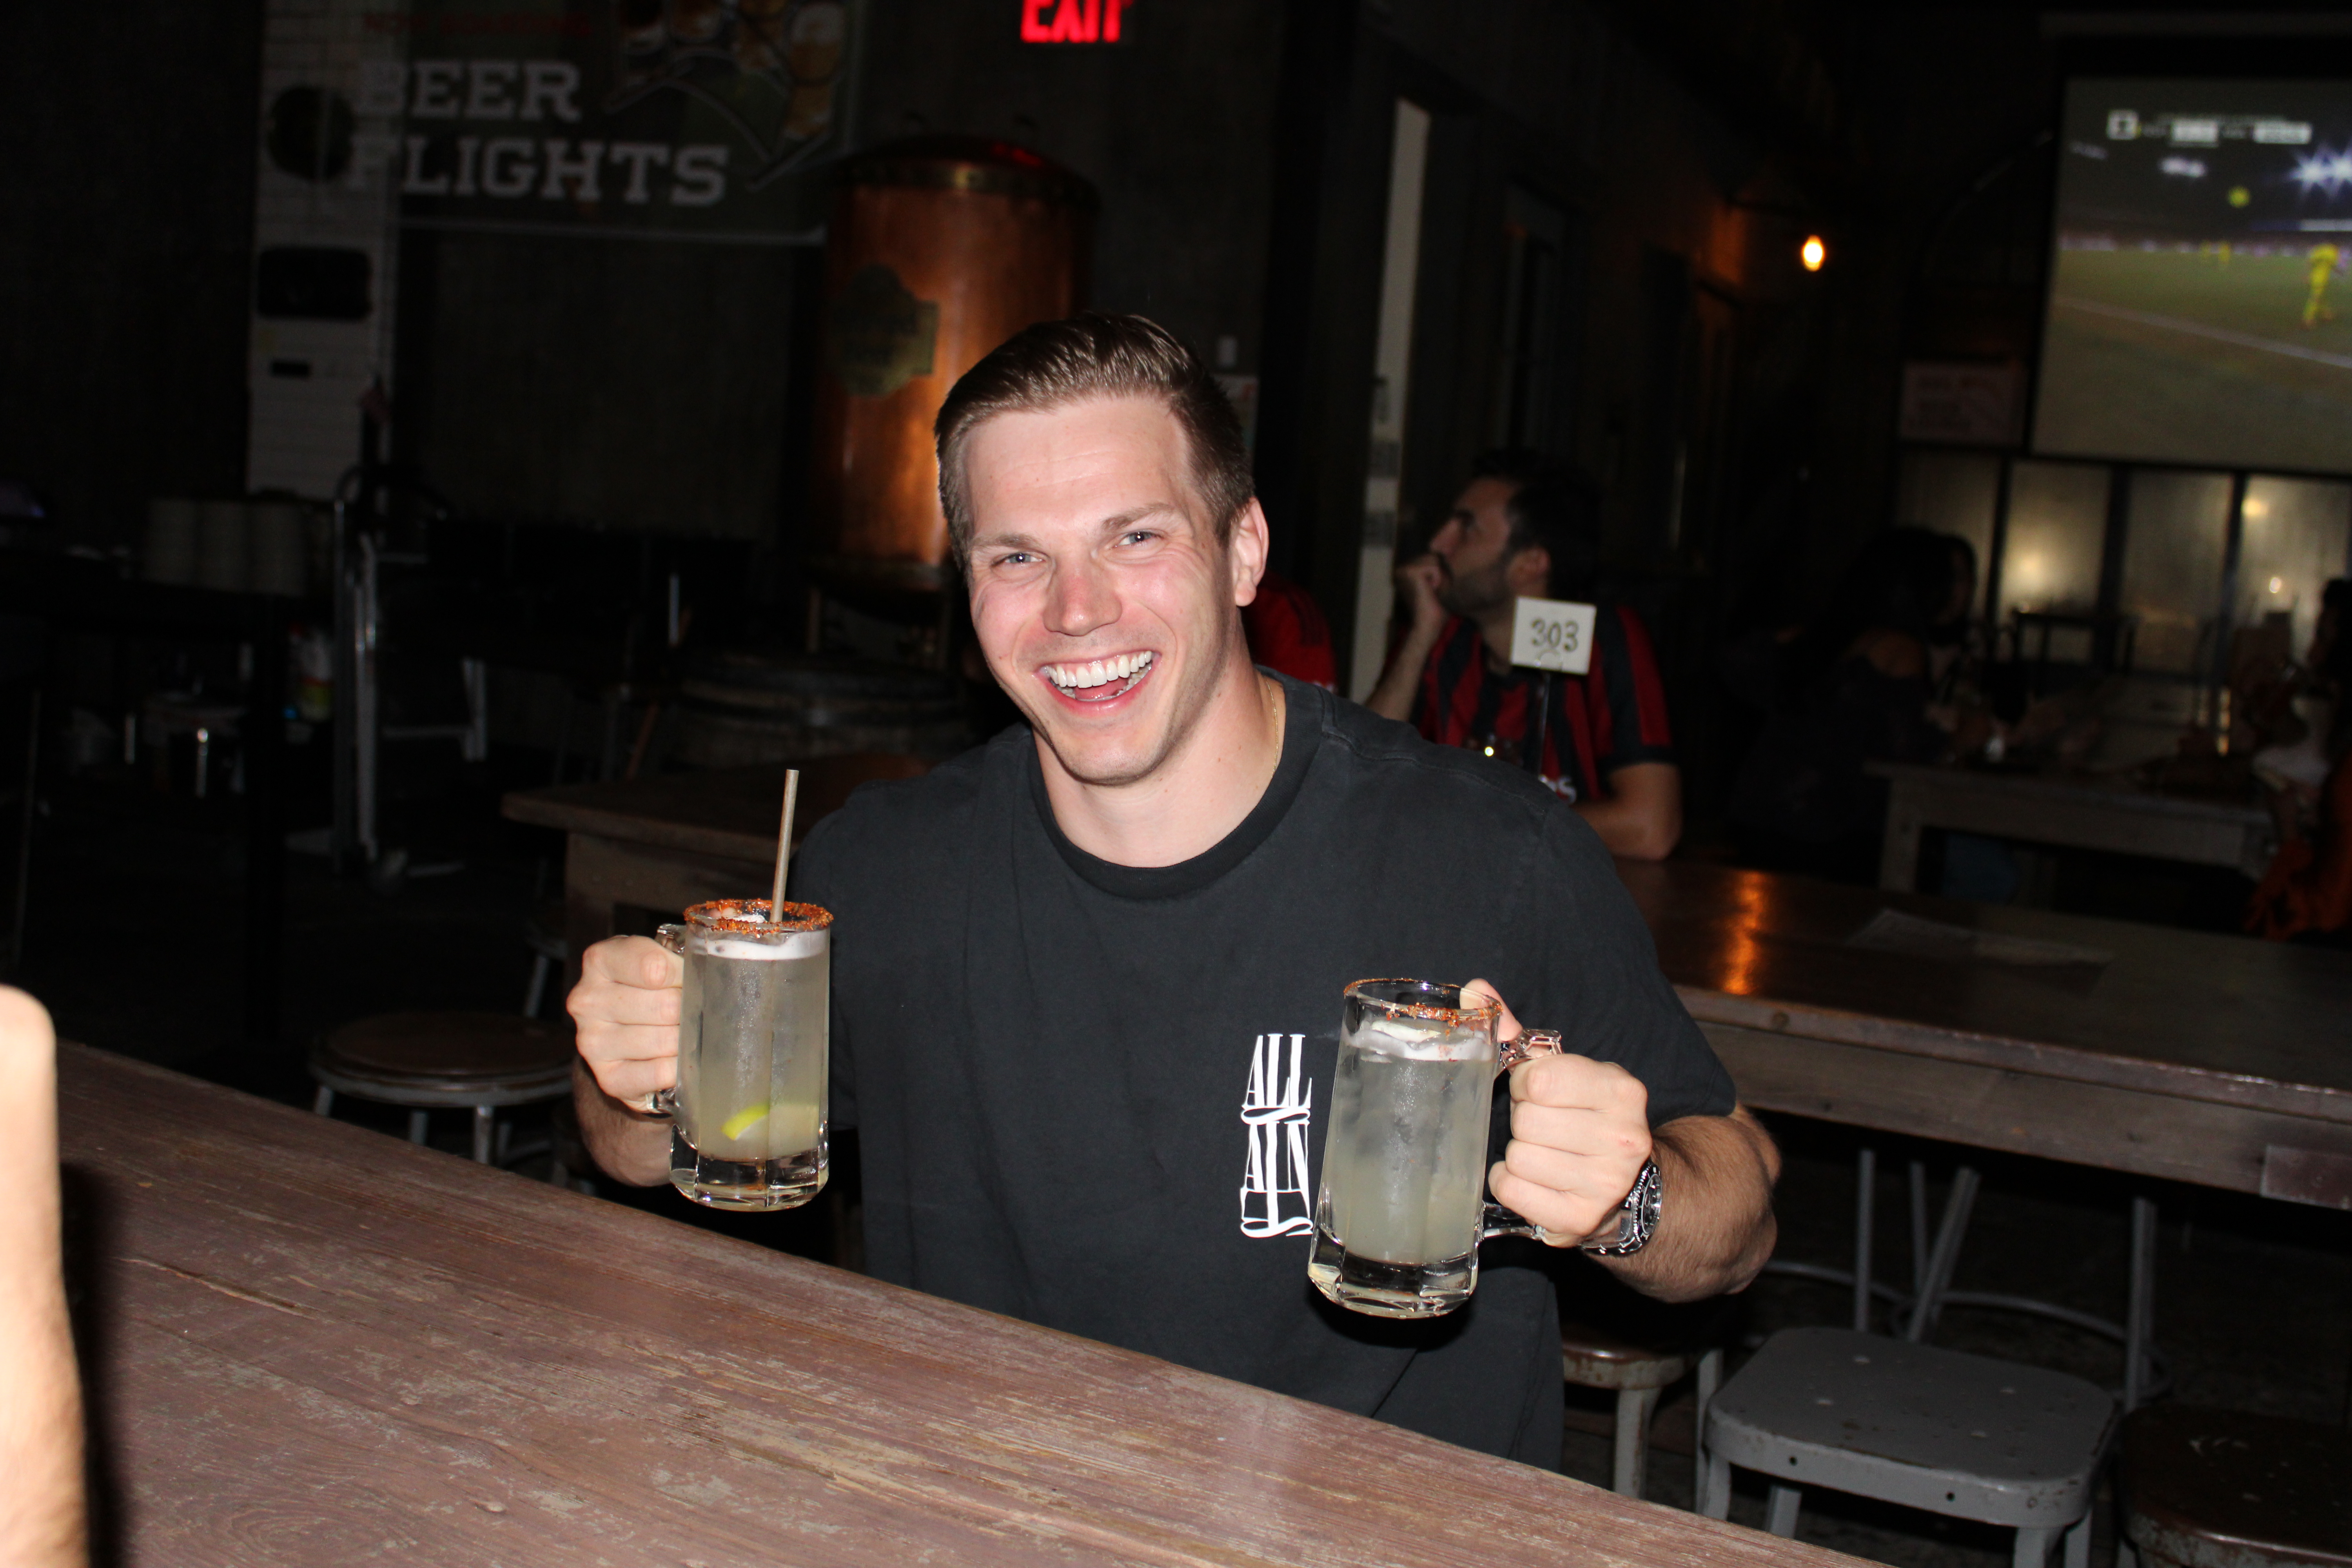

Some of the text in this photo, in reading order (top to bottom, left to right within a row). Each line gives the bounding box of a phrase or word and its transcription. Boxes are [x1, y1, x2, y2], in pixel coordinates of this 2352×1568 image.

[355, 59, 583, 123] BEER
[347, 134, 731, 207] FLIGHTS
[1531, 618, 1579, 652] 303
